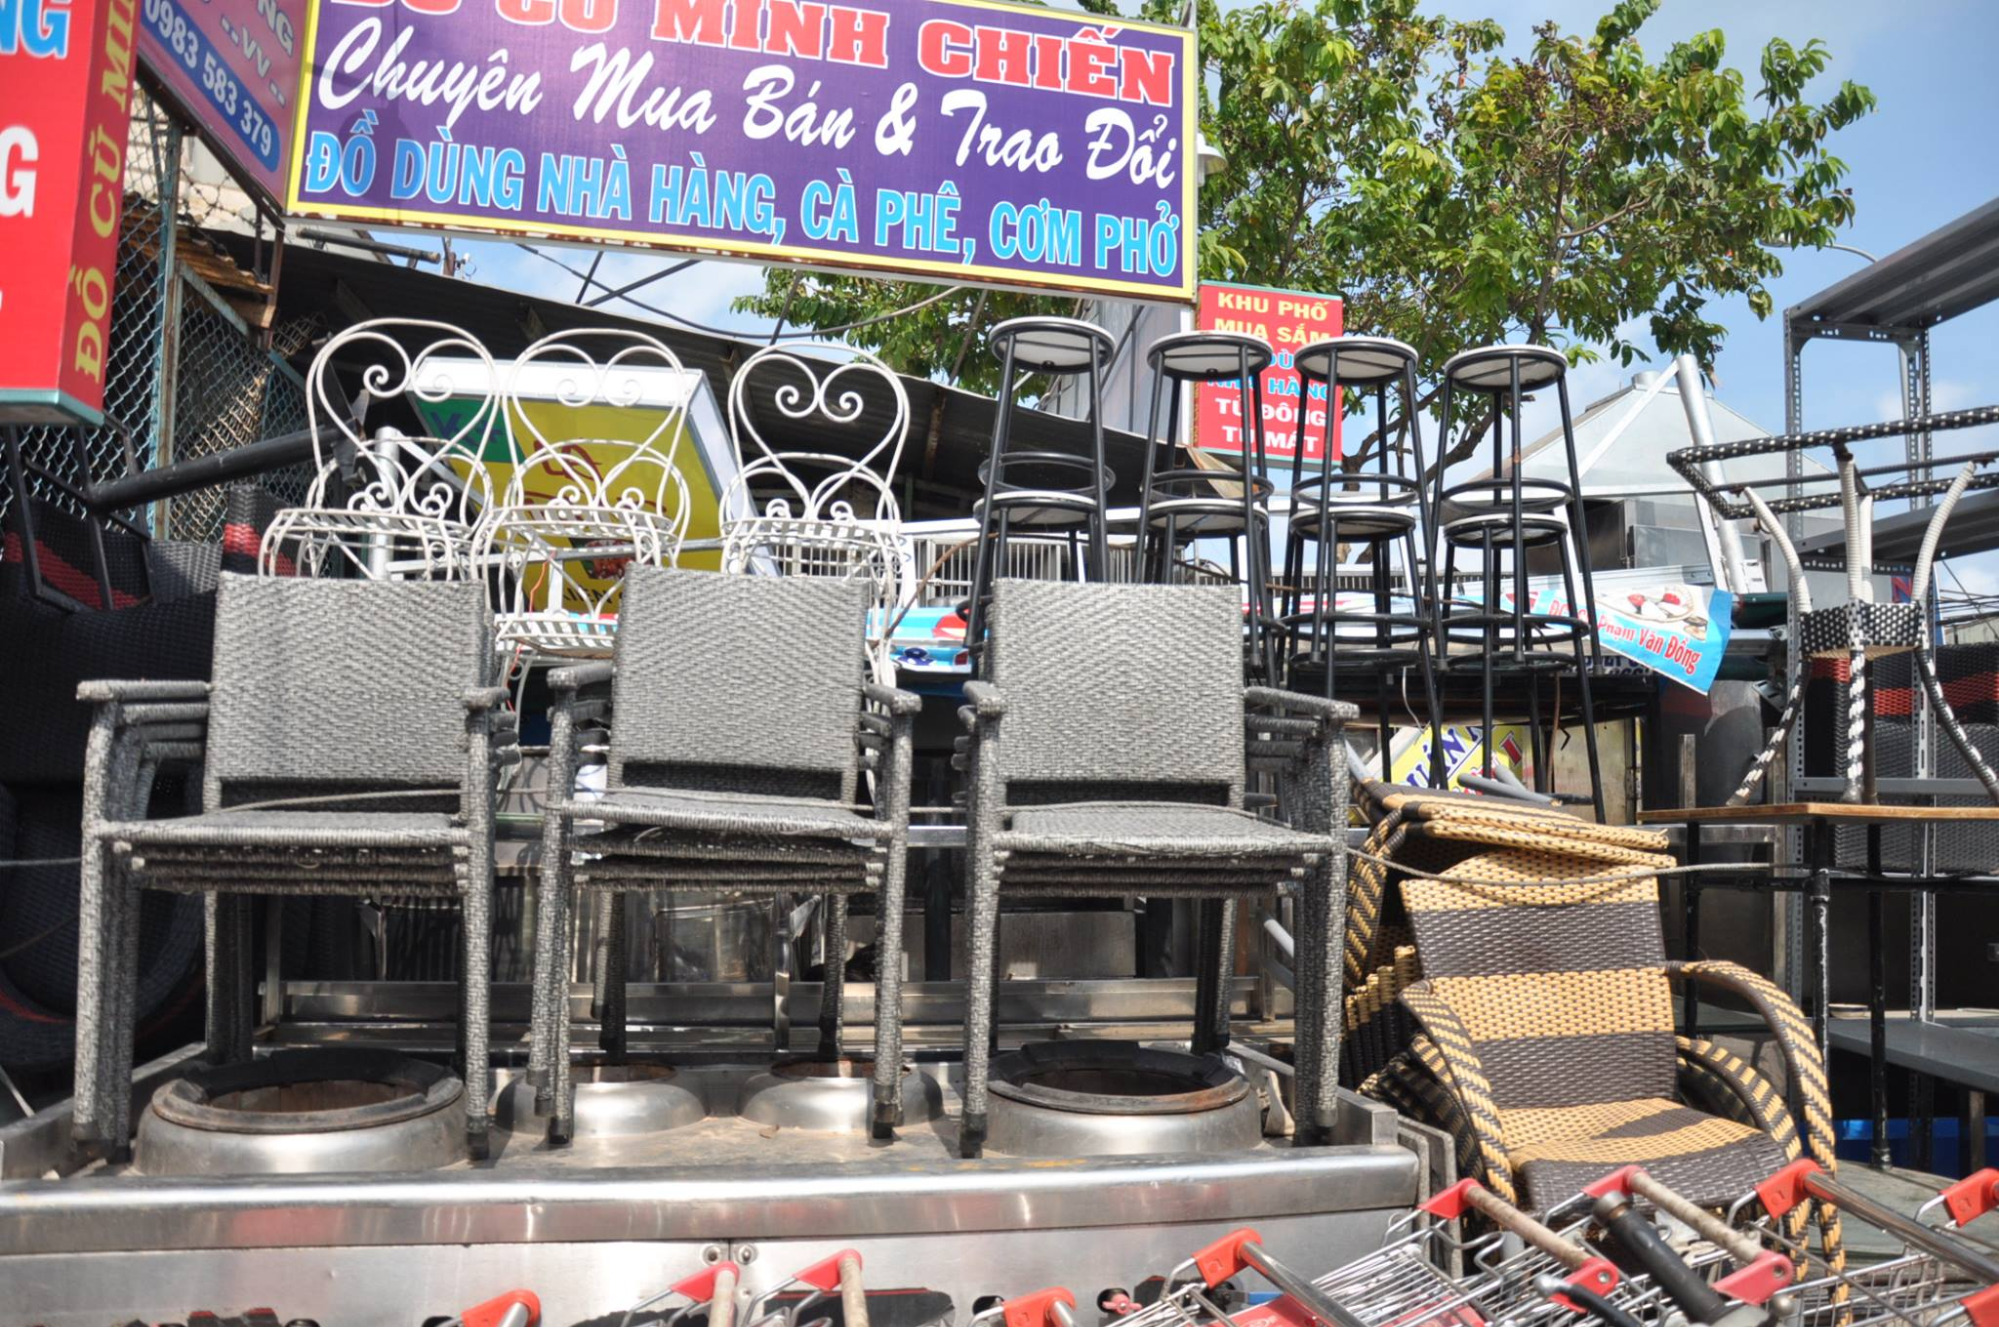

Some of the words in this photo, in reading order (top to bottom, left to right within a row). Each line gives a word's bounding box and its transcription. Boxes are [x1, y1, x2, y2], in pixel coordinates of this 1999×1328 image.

[101, 0, 138, 114] MI
[144, 0, 200, 69] 0983
[202, 52, 238, 117] 583
[240, 100, 273, 157] 379
[319, 17, 543, 129] Chuyên
[570, 42, 718, 135] Mua
[742, 64, 856, 150] Bán
[874, 82, 919, 157] &
[940, 88, 1063, 173] Trao
[1084, 107, 1178, 189] Đổi
[650, 0, 890, 69] MINH
[917, 19, 1175, 107] CHIẾN
[89, 124, 122, 239] CŨ
[304, 108, 379, 198] ĐỒ
[389, 125, 526, 212] DÙNG
[536, 143, 633, 221] NHÀ
[648, 151, 787, 247] HÀNG,
[800, 167, 860, 244] CÀ
[874, 180, 977, 266] PHÊ,
[988, 197, 1083, 267] CƠM
[1094, 199, 1181, 278] PHỞ
[68, 264, 109, 385] ĐỒ
[1214, 318, 1269, 341] MUA
[1276, 322, 1331, 345] SẮM
[1217, 292, 1270, 314] KHU
[1277, 300, 1331, 322] PHỐ
